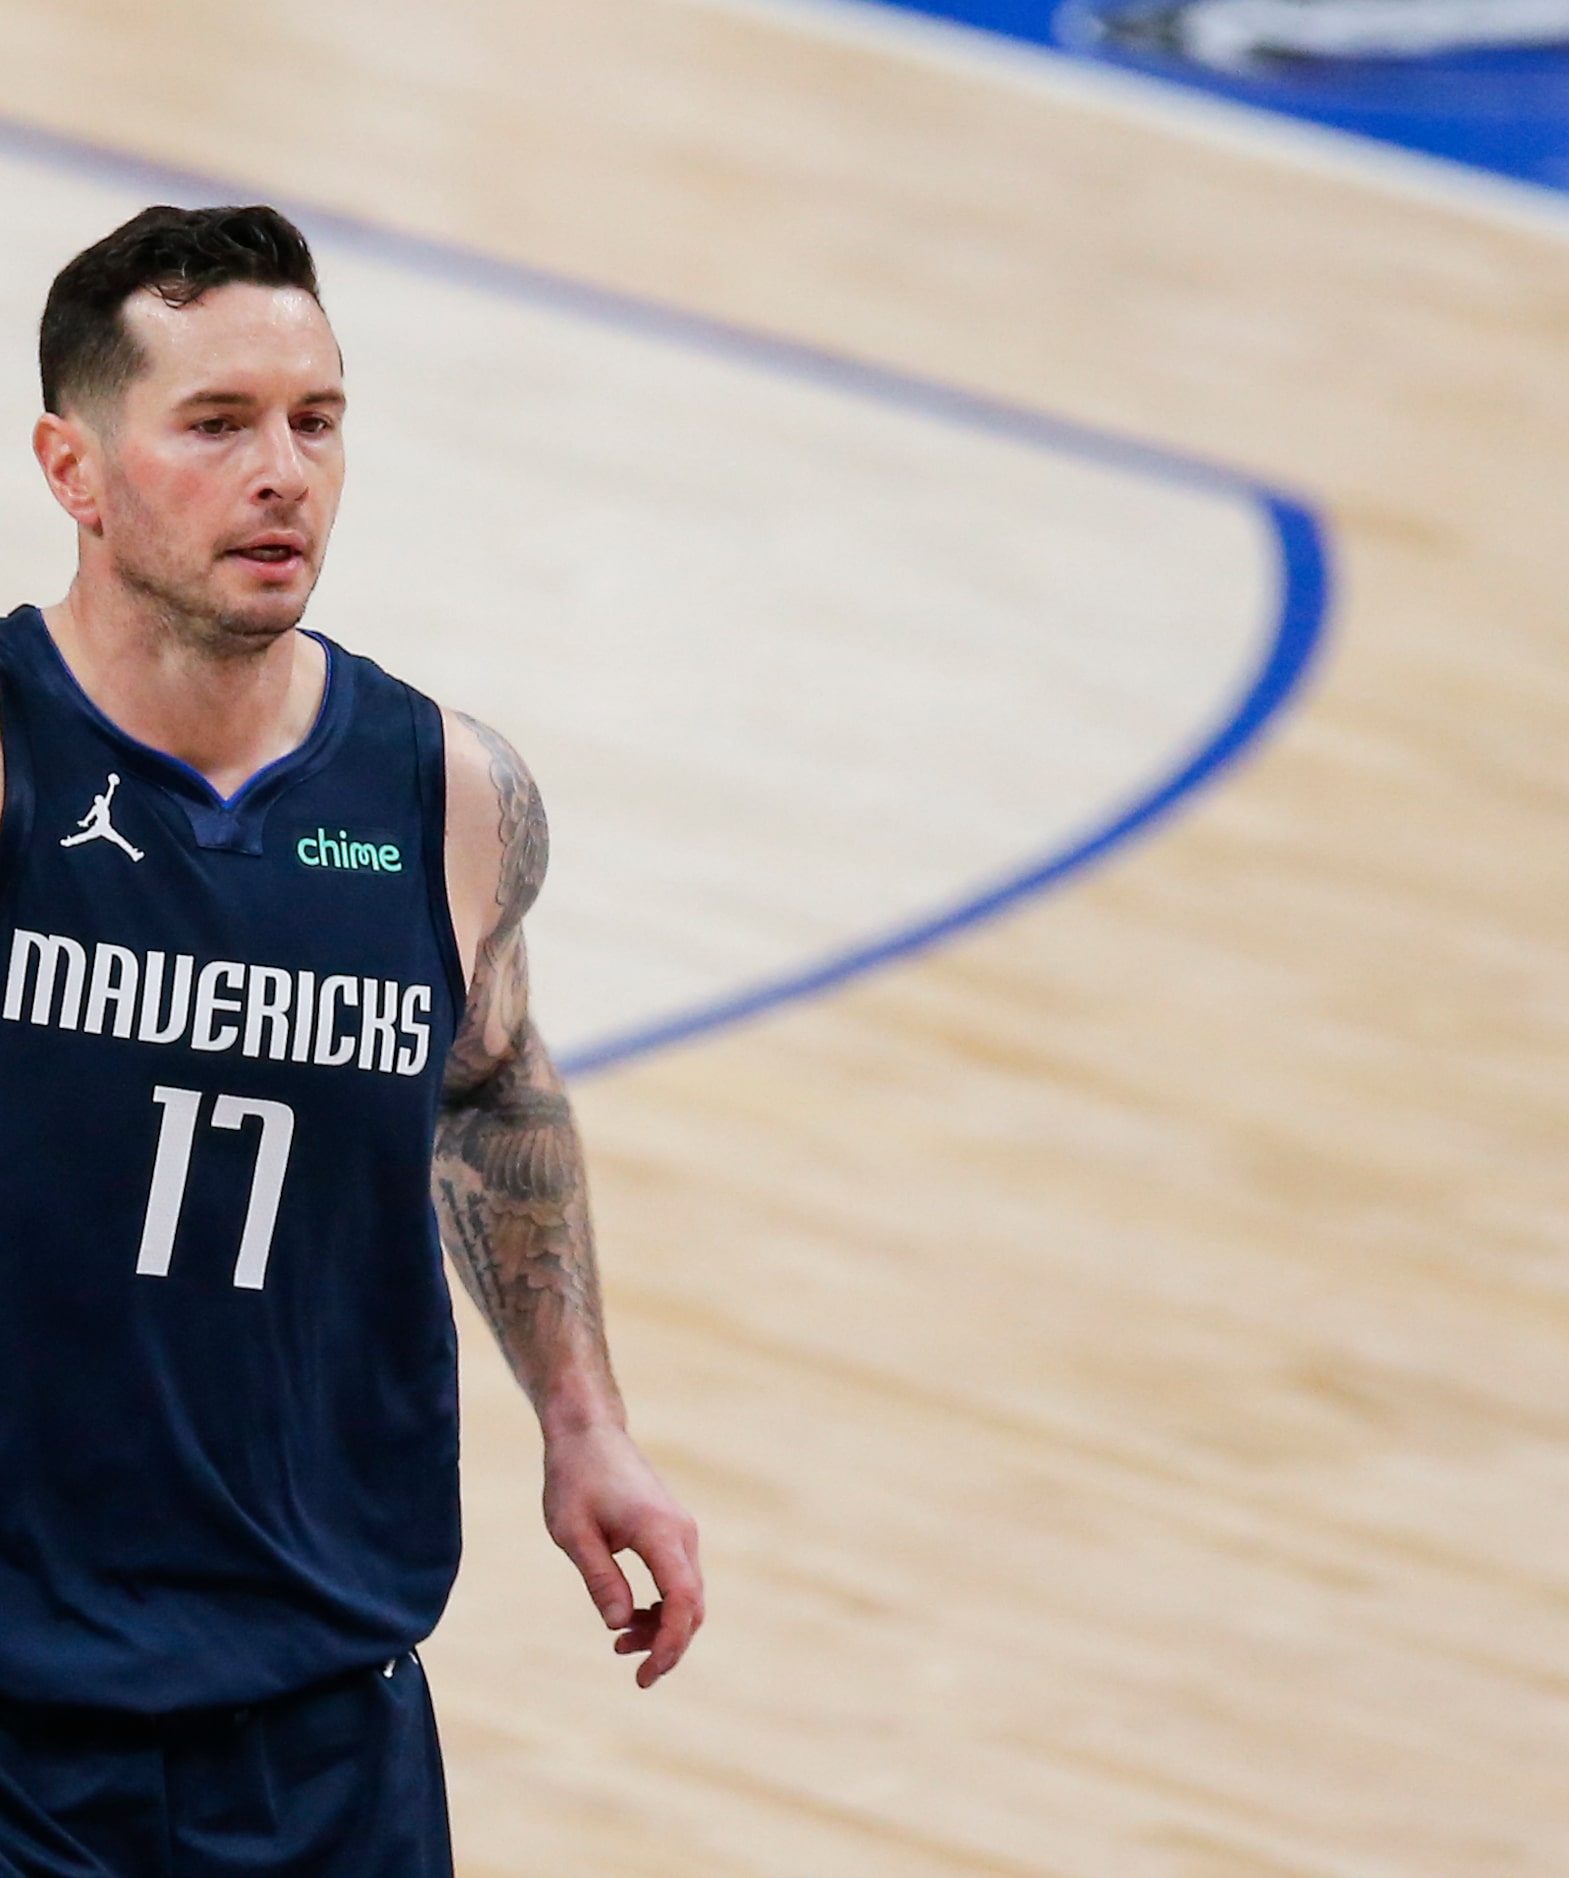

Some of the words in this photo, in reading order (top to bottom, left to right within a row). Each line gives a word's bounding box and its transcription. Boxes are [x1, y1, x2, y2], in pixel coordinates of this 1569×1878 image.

[297, 828, 402, 873] chime
[2, 929, 431, 1076] MAVERICKS
[136, 1086, 294, 1289] 17
